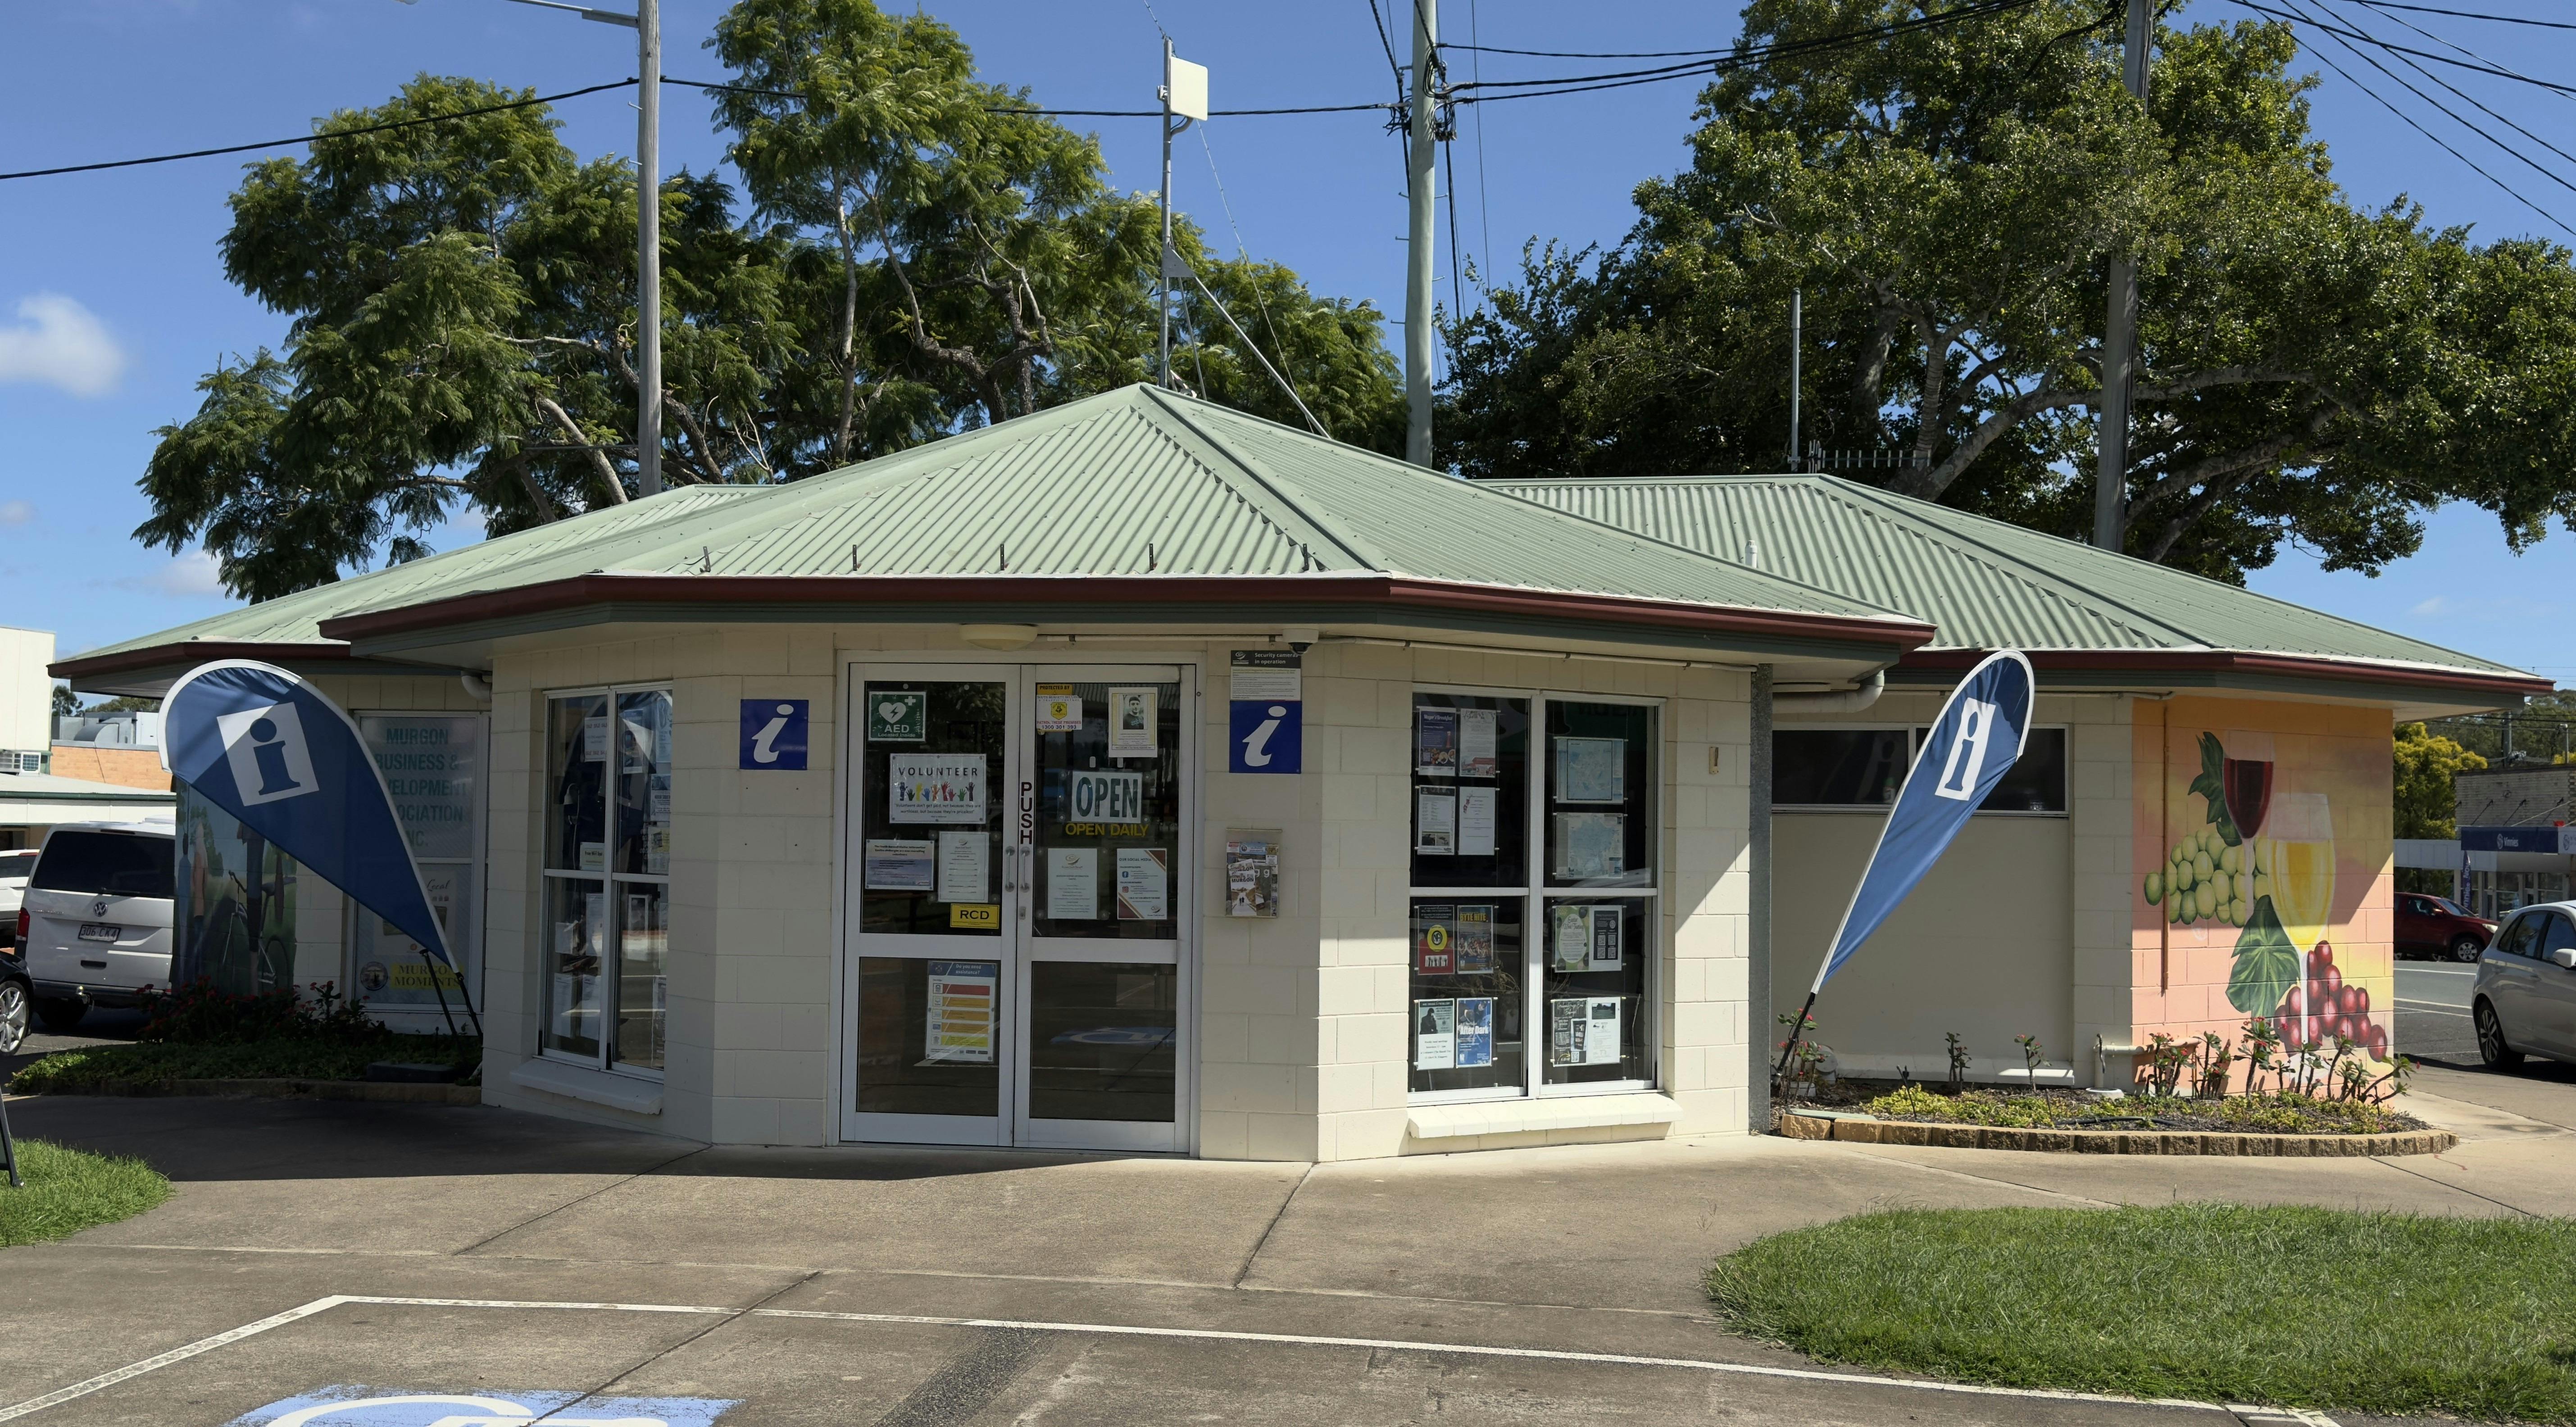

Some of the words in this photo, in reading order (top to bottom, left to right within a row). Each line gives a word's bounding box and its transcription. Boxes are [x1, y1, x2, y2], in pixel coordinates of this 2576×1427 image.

[386, 728, 449, 744] MURGON
[884, 724, 909, 733] AED
[375, 753, 445, 770] BUSINESS
[449, 754, 459, 770] &
[899, 767, 978, 776] VOLUNTEER
[388, 779, 467, 796] ELOPMENT
[1076, 777, 1138, 818] OPEN
[396, 804, 463, 822] OCIATION
[1020, 782, 1032, 844] PUSH
[1065, 823, 1105, 836] OPEN
[1110, 823, 1149, 837] DAILY
[406, 830, 429, 847] NC.
[2503, 836, 2519, 847] Vinnies
[2463, 882, 2471, 909] innies
[960, 910, 989, 920] RCD
[82, 927, 96, 936] 306
[399, 965, 450, 974] MURO
[1460, 1025, 1474, 1035] After
[1475, 1025, 1489, 1034] Dark
